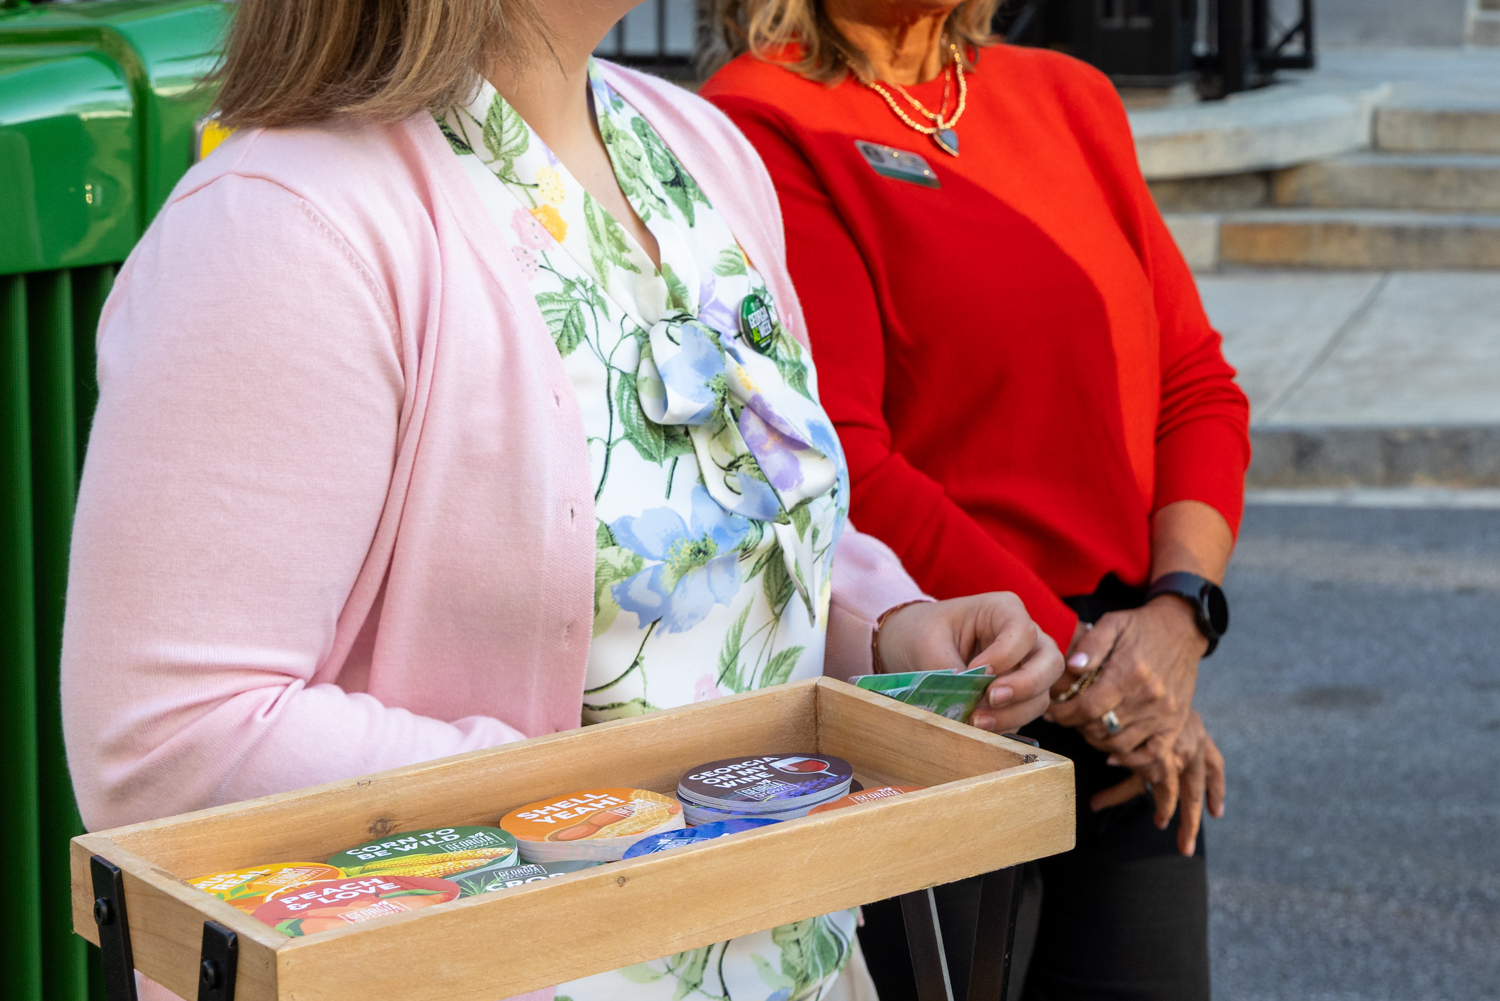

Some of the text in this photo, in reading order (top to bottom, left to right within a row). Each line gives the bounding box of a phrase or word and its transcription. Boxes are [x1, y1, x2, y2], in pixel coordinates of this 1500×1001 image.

[688, 756, 780, 781] GEORGIA
[702, 764, 770, 786] ON MY
[713, 772, 774, 789] WINE
[516, 793, 610, 820] SHELL
[532, 796, 627, 824] YEAH!
[346, 828, 456, 856] CORN TO
[356, 834, 461, 861] BE WILD
[446, 834, 499, 851] GEORGIA
[210, 869, 272, 890] REAL
[498, 865, 542, 878] GEORGIA
[279, 878, 384, 904] PEACH
[286, 882, 401, 911] & LOVE
[345, 903, 406, 920] GEORGIA
